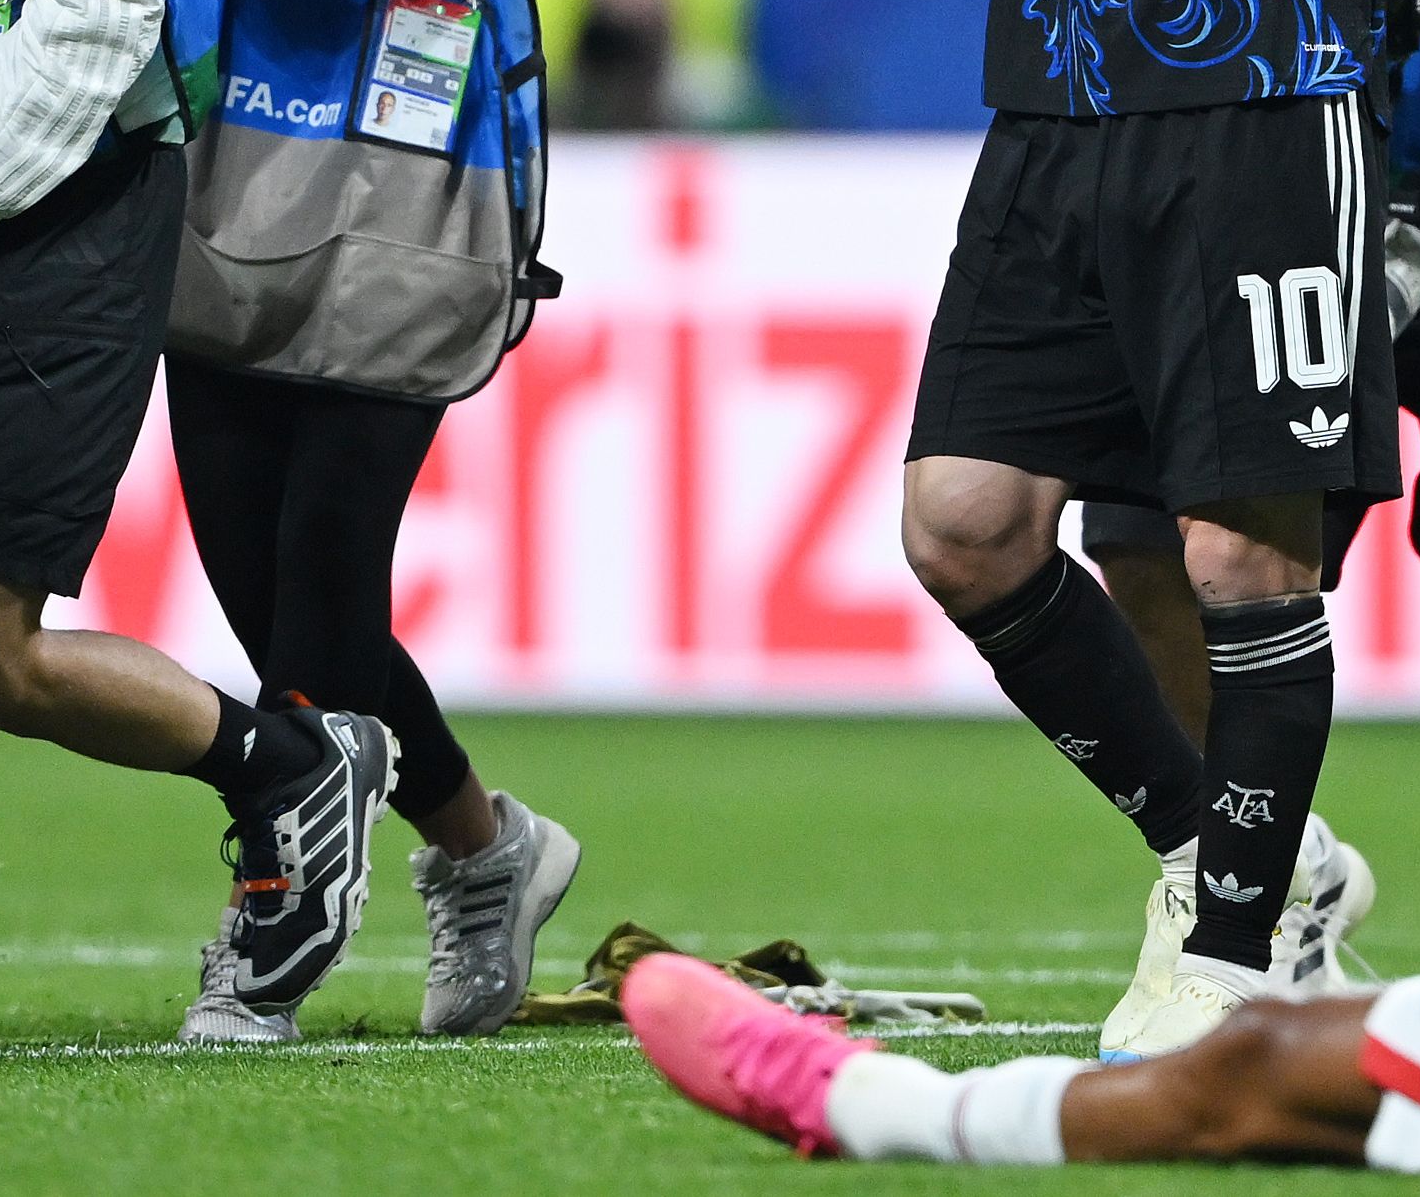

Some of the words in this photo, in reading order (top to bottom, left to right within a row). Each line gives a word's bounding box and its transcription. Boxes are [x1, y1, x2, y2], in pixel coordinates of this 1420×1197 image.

[225, 75, 342, 128] FA.com
[1237, 266, 1349, 393] 10
[1212, 781, 1275, 829] AFA
